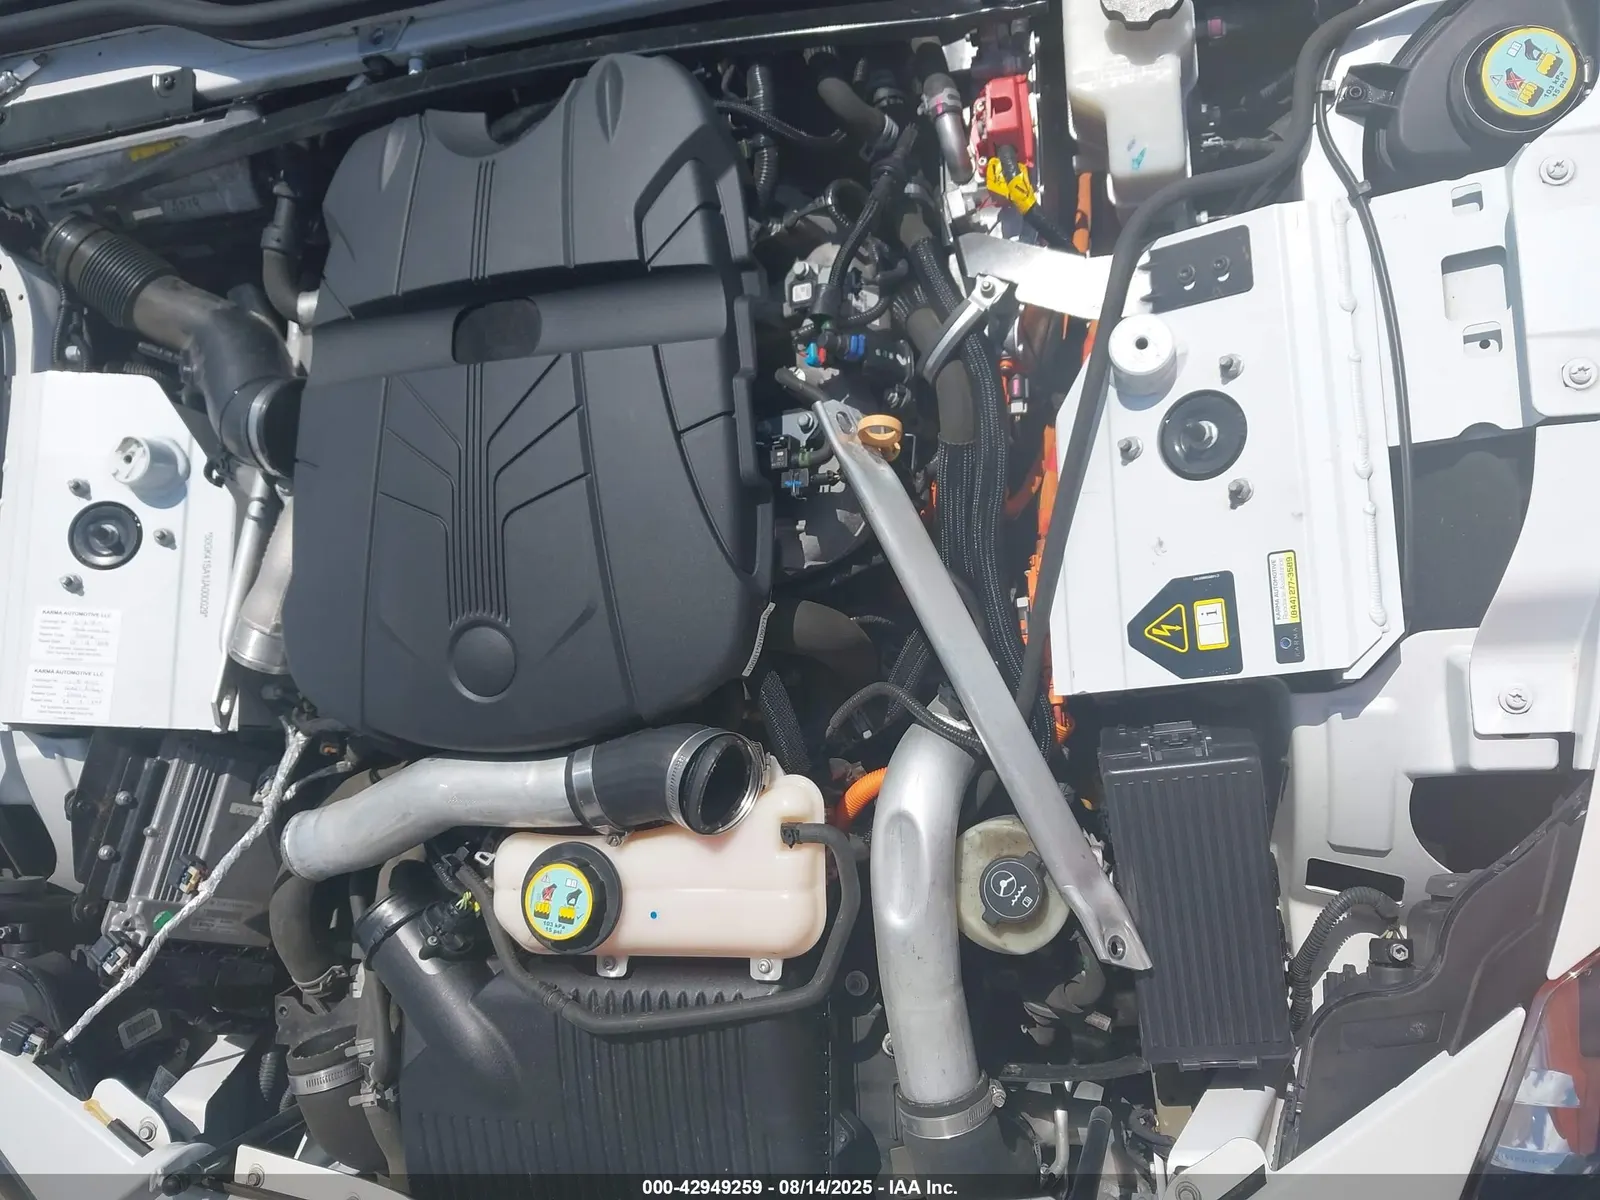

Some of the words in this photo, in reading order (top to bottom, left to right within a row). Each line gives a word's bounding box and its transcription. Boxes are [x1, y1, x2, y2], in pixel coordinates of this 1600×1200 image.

[1543, 85, 1555, 98] 103
[1552, 71, 1564, 86] kPa
[1552, 88, 1560, 98] 15
[1559, 77, 1569, 89] psi
[1271, 559, 1279, 598] AUTOMOTIVE
[1286, 556, 1296, 595] 277-3589
[1289, 596, 1299, 619] (844)
[555, 922, 566, 930] kPa
